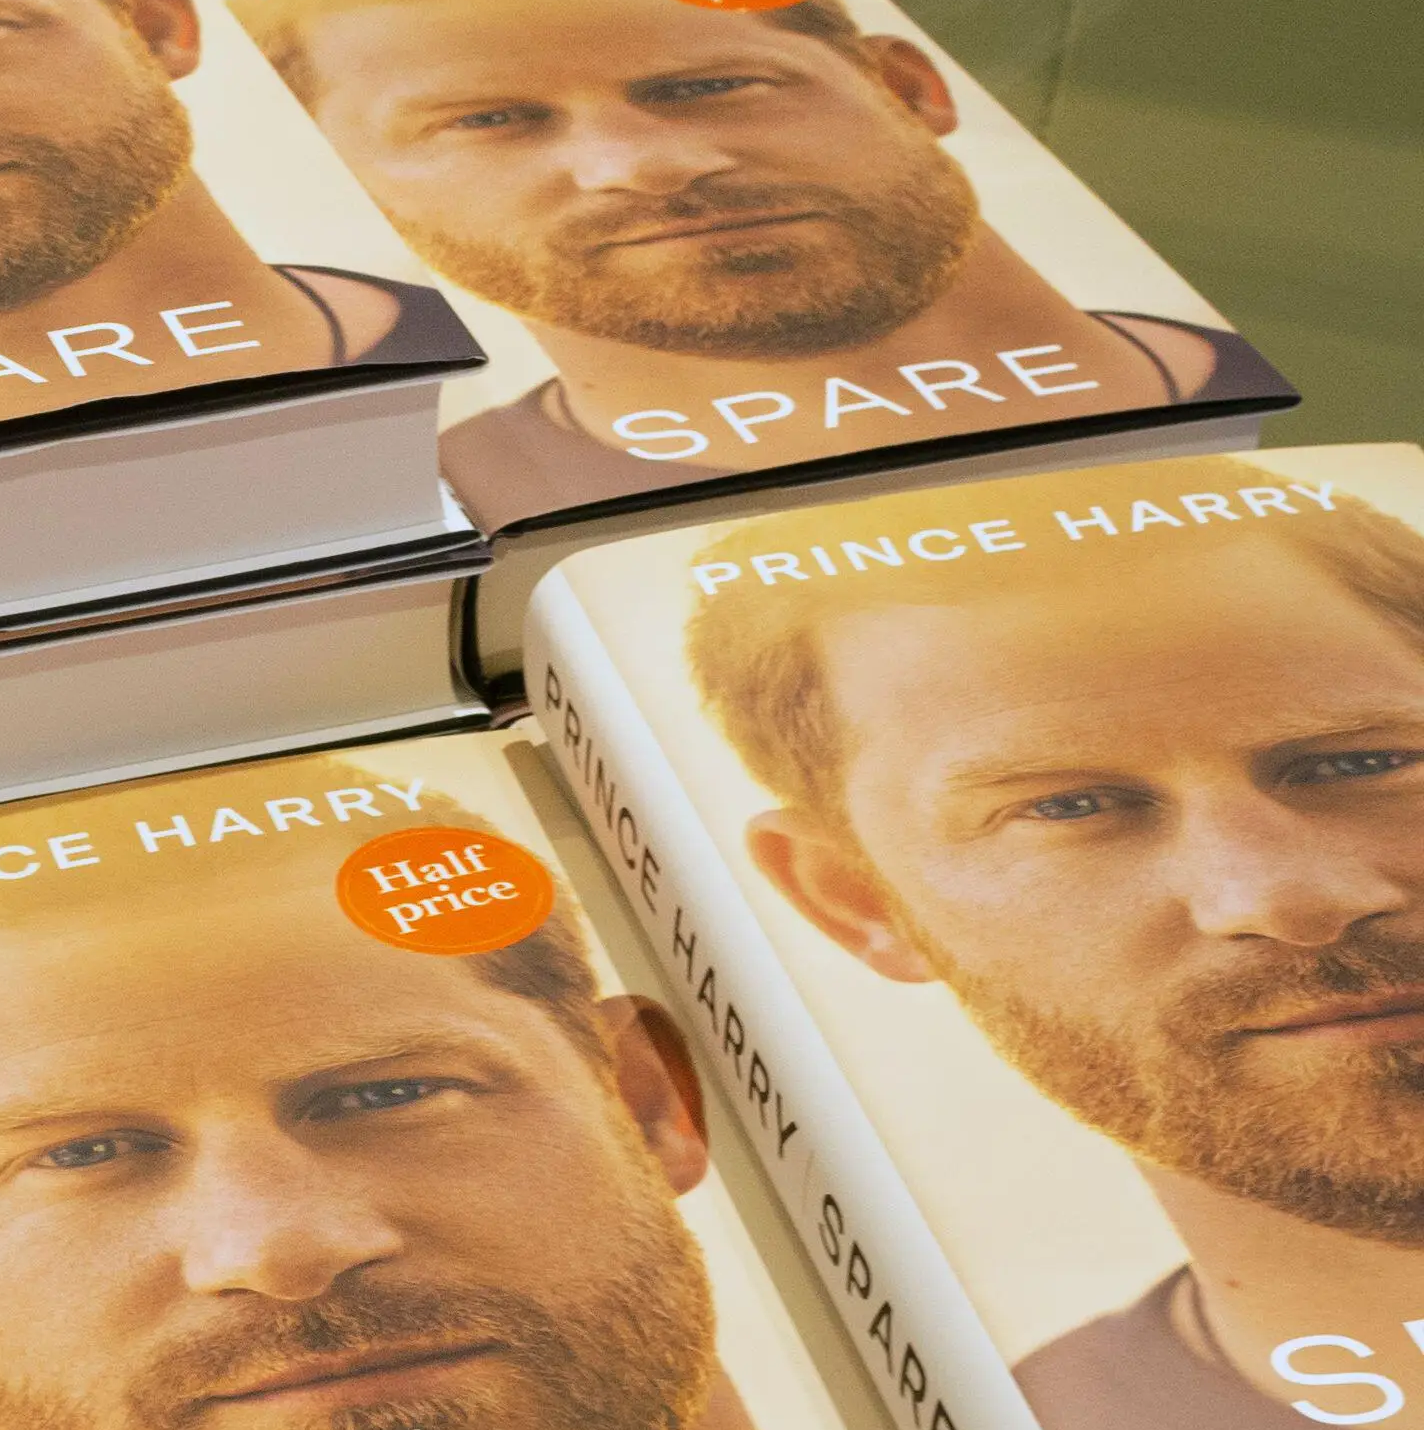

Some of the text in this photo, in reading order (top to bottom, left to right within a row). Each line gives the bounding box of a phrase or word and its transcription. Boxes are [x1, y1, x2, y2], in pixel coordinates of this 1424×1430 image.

[611, 343, 1099, 460] SPARE
[691, 480, 1338, 595] PRINCE HARRY
[134, 777, 425, 853] HARRY
[367, 844, 495, 895] Half
[384, 879, 520, 935] price
[544, 661, 661, 915] PRINCE
[672, 906, 797, 1159] HARRY
